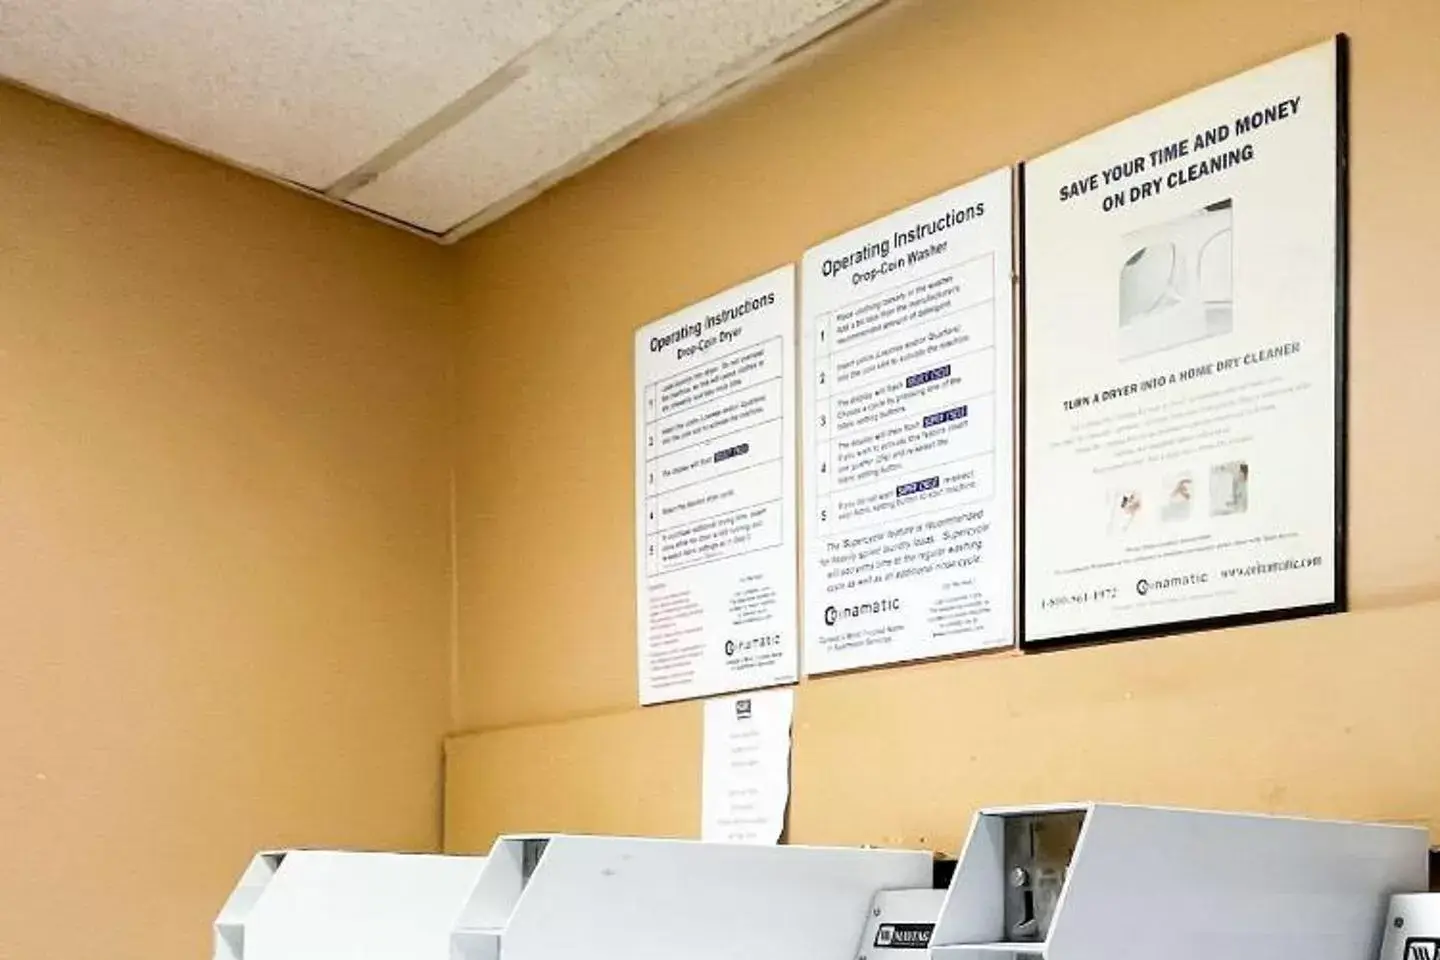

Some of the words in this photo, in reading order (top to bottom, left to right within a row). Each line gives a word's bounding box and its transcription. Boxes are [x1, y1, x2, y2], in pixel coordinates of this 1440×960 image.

[1058, 173, 1098, 201] SAVE
[1102, 157, 1145, 185] YOUR
[1149, 139, 1189, 166] TIME
[1193, 125, 1229, 152] AND
[1235, 96, 1301, 136] MONEY
[1102, 191, 1125, 212] ON
[1129, 178, 1163, 203] DRY
[1167, 145, 1254, 188] CLEANING
[822, 239, 889, 277] Operating
[894, 202, 985, 248] Instructions
[852, 254, 905, 285] Drop-Coin
[907, 241, 948, 265] Washer
[649, 322, 701, 352] Operating
[704, 292, 775, 330] Instructions
[719, 327, 742, 344] Dryer
[1063, 396, 1091, 412] TURN
[1092, 392, 1101, 405] A
[1102, 383, 1138, 402] DRYER
[1140, 375, 1166, 392] INTO
[1168, 374, 1177, 385] A
[1180, 364, 1213, 382] HOME
[1216, 356, 1241, 372] DRY
[1243, 341, 1301, 366] CLEANER
[824, 597, 900, 626] Coinamatic
